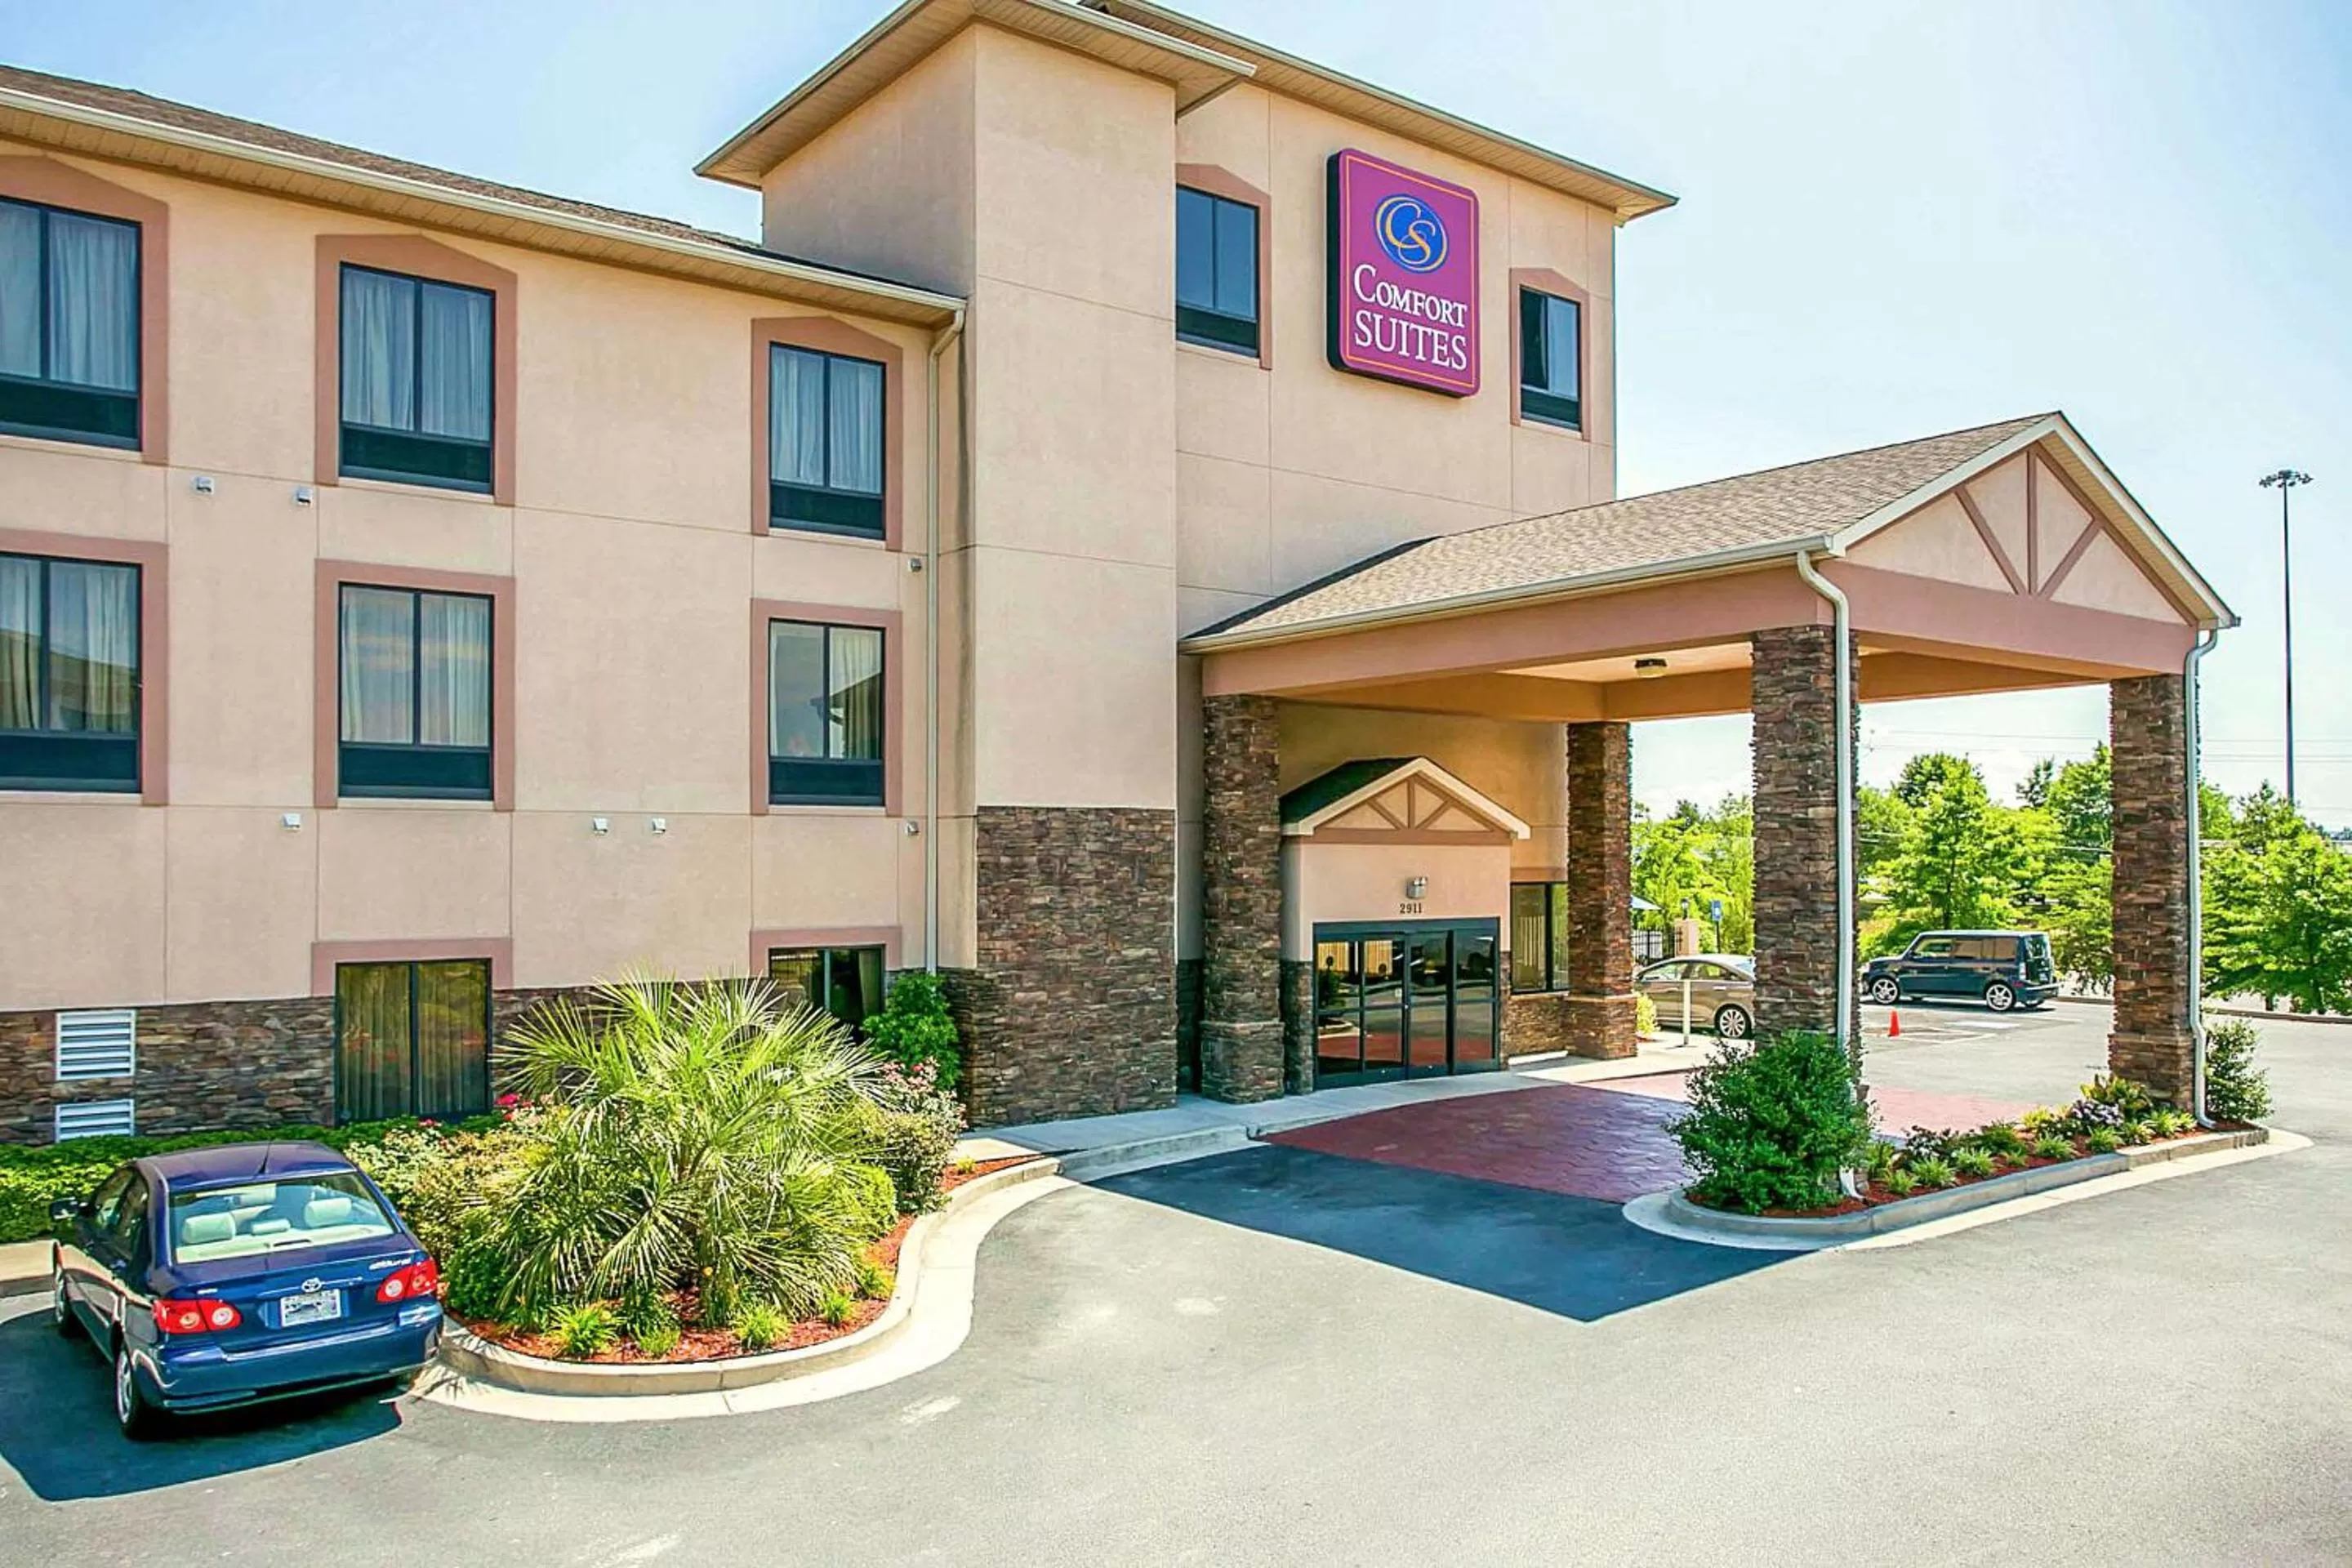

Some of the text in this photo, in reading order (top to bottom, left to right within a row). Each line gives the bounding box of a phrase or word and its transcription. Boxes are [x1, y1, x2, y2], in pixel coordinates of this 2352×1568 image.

[1353, 264, 1468, 328] COMFORT
[1354, 310, 1468, 371] SUITES
[1400, 902, 1422, 914] 2911
